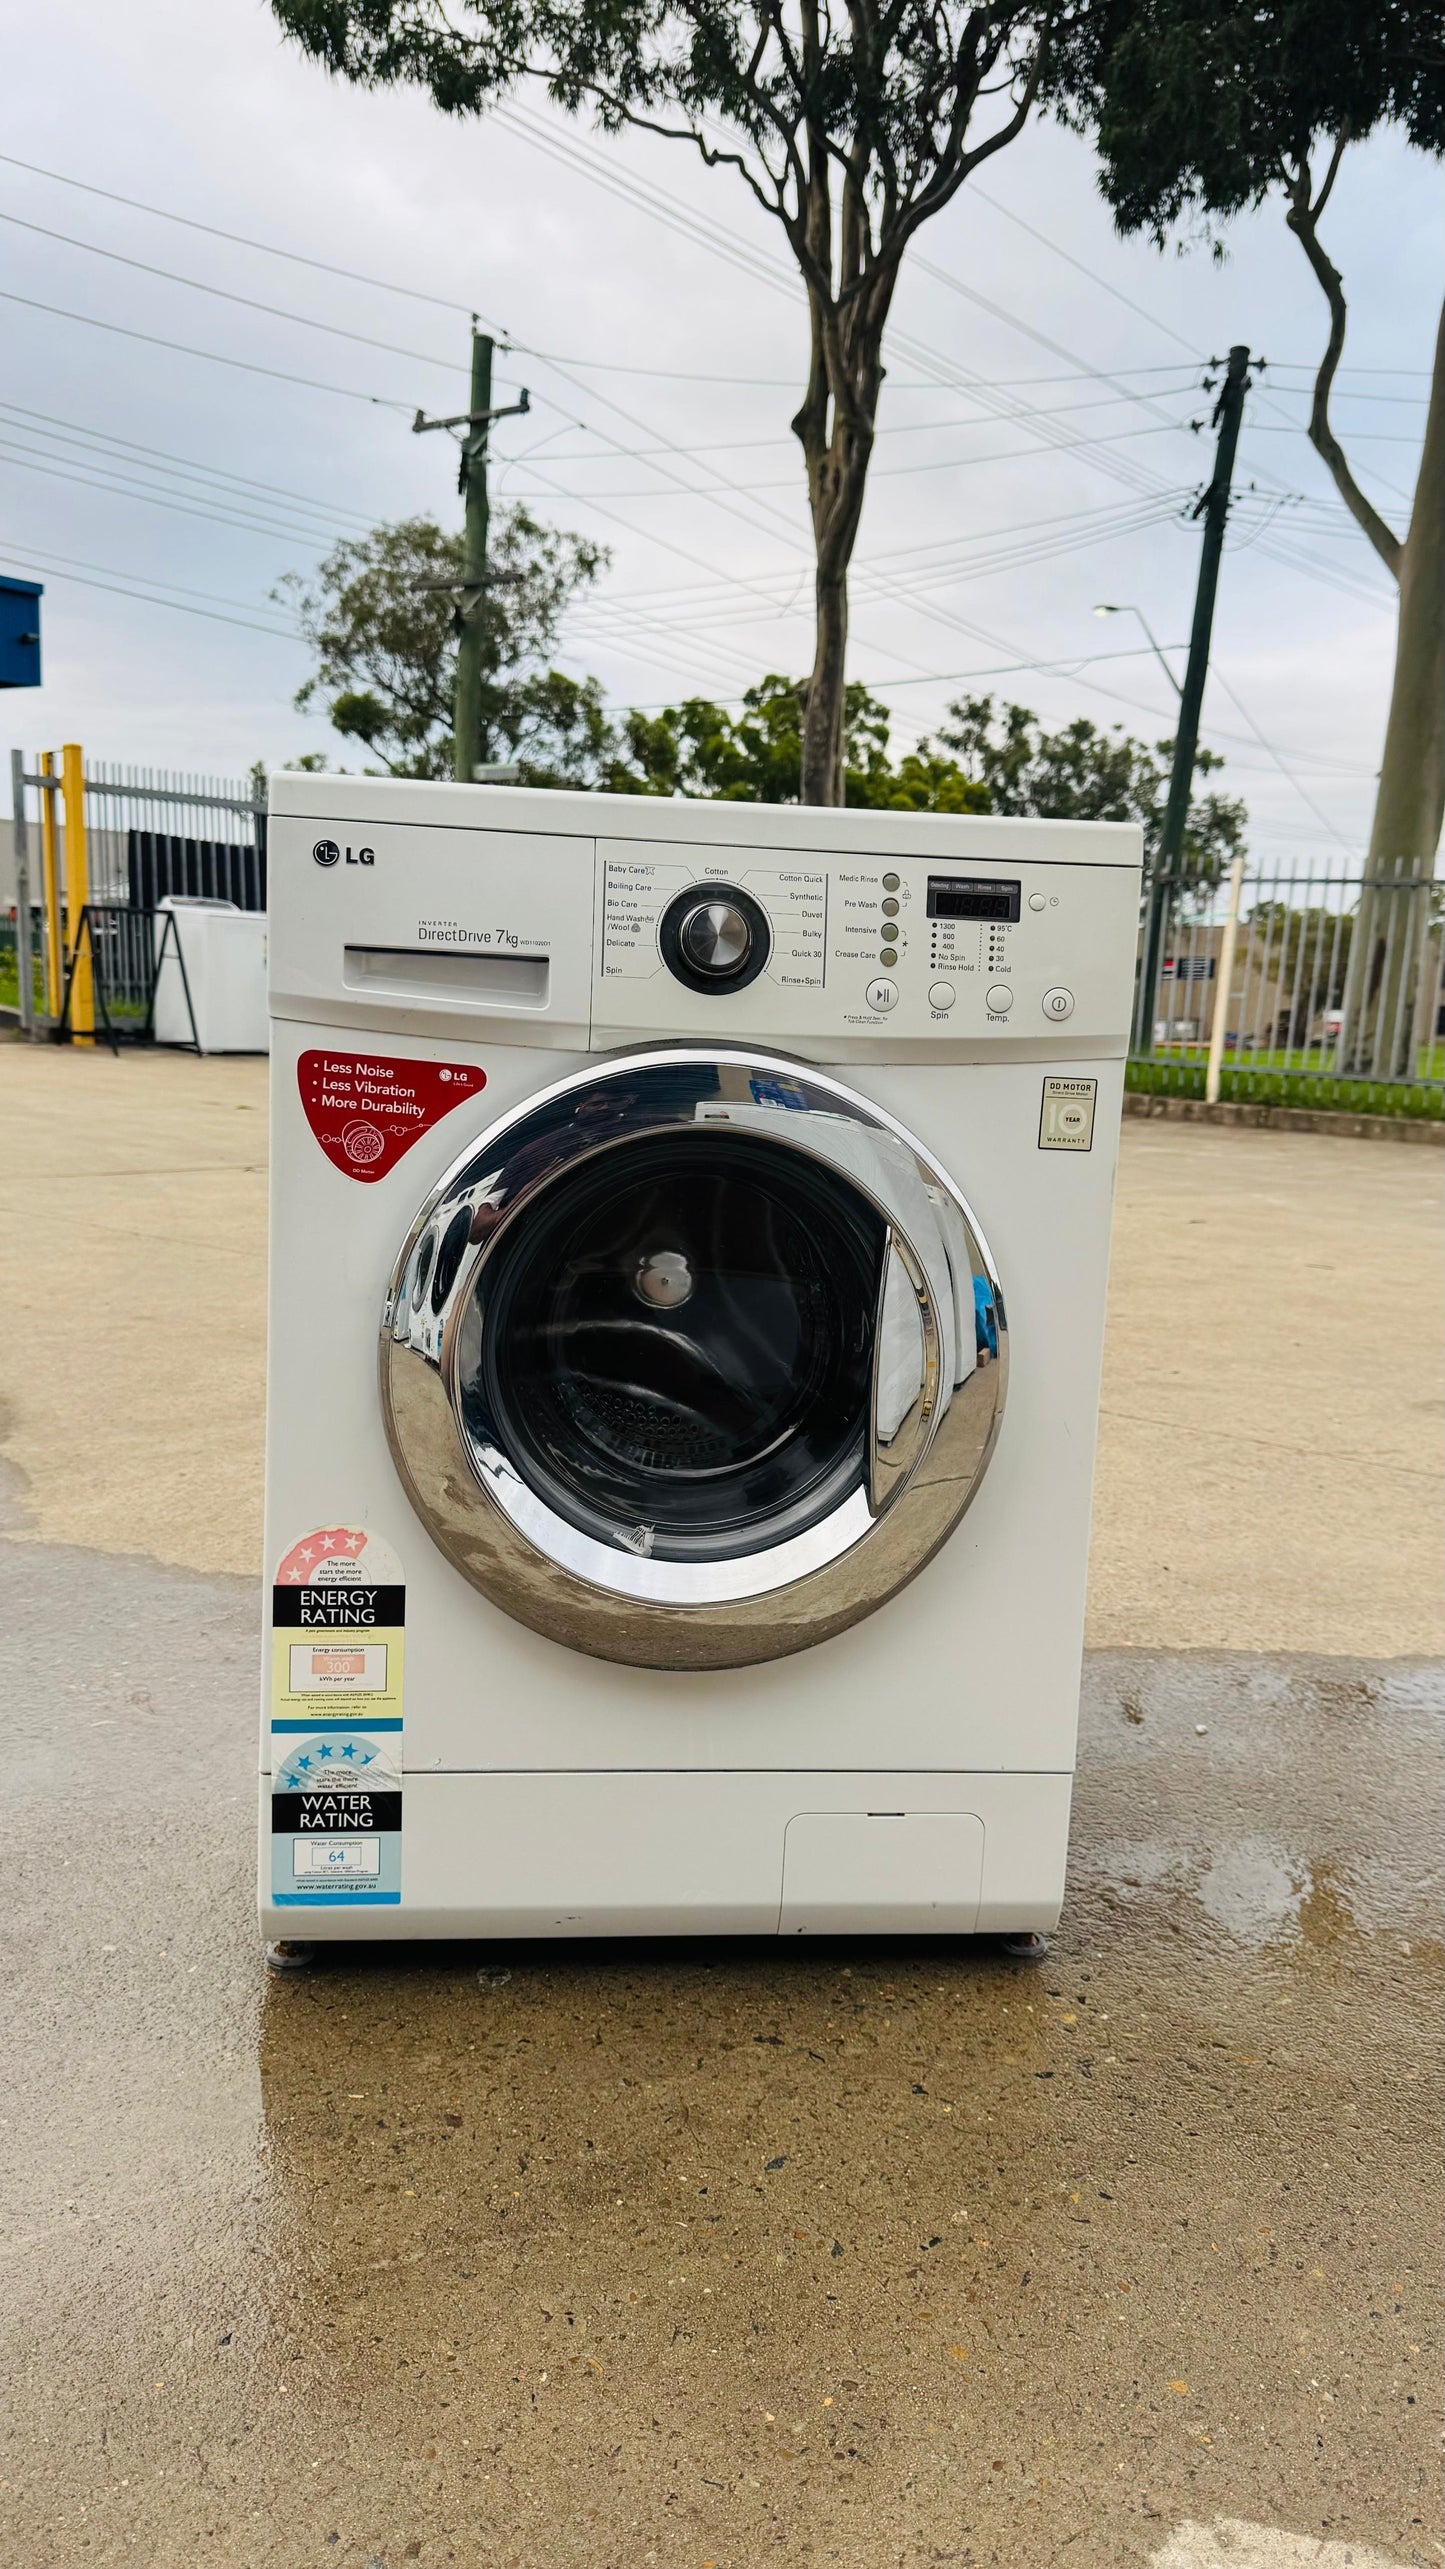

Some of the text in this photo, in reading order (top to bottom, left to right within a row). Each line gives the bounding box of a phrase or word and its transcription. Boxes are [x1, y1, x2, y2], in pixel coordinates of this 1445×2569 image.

[346, 847, 375, 865] LG
[608, 865, 646, 874] Baby Care
[704, 867, 729, 875] Cotton
[779, 874, 823, 883] Cotton Quick
[839, 874, 879, 883] Medic Rinse
[608, 882, 652, 891] Boiling Care
[790, 892, 823, 902] Synthetic
[607, 899, 638, 908] Bio Care
[844, 900, 878, 909] Pre Wash
[607, 923, 630, 931] /Wool
[845, 926, 877, 935] Intensive
[802, 930, 823, 938] Bulky
[606, 939, 636, 947] Delicate
[791, 949, 811, 958] Quick
[835, 950, 877, 959] Crease Care
[950, 954, 966, 962] Spin
[605, 966, 623, 975] Spin
[937, 963, 957, 971] Rinse
[995, 965, 1012, 973] Cold
[781, 976, 821, 985] Rinse+Spin
[930, 1011, 949, 1020] Spin
[986, 1013, 1010, 1023] Temp.
[323, 1060, 395, 1078] Less Noise
[453, 1072, 468, 1082] LG
[322, 1077, 416, 1098] Less Vibration
[1050, 1082, 1092, 1092] DD MOTOR
[321, 1095, 426, 1118] More Durability
[300, 1590, 378, 1606] ENERGY
[300, 1608, 375, 1624] RATING
[326, 1661, 350, 1673] 300
[301, 1795, 372, 1810] WATER
[300, 1812, 373, 1828] RATING
[328, 1850, 345, 1862] 64
[296, 1883, 377, 1891] www.waterrating.gov.au
